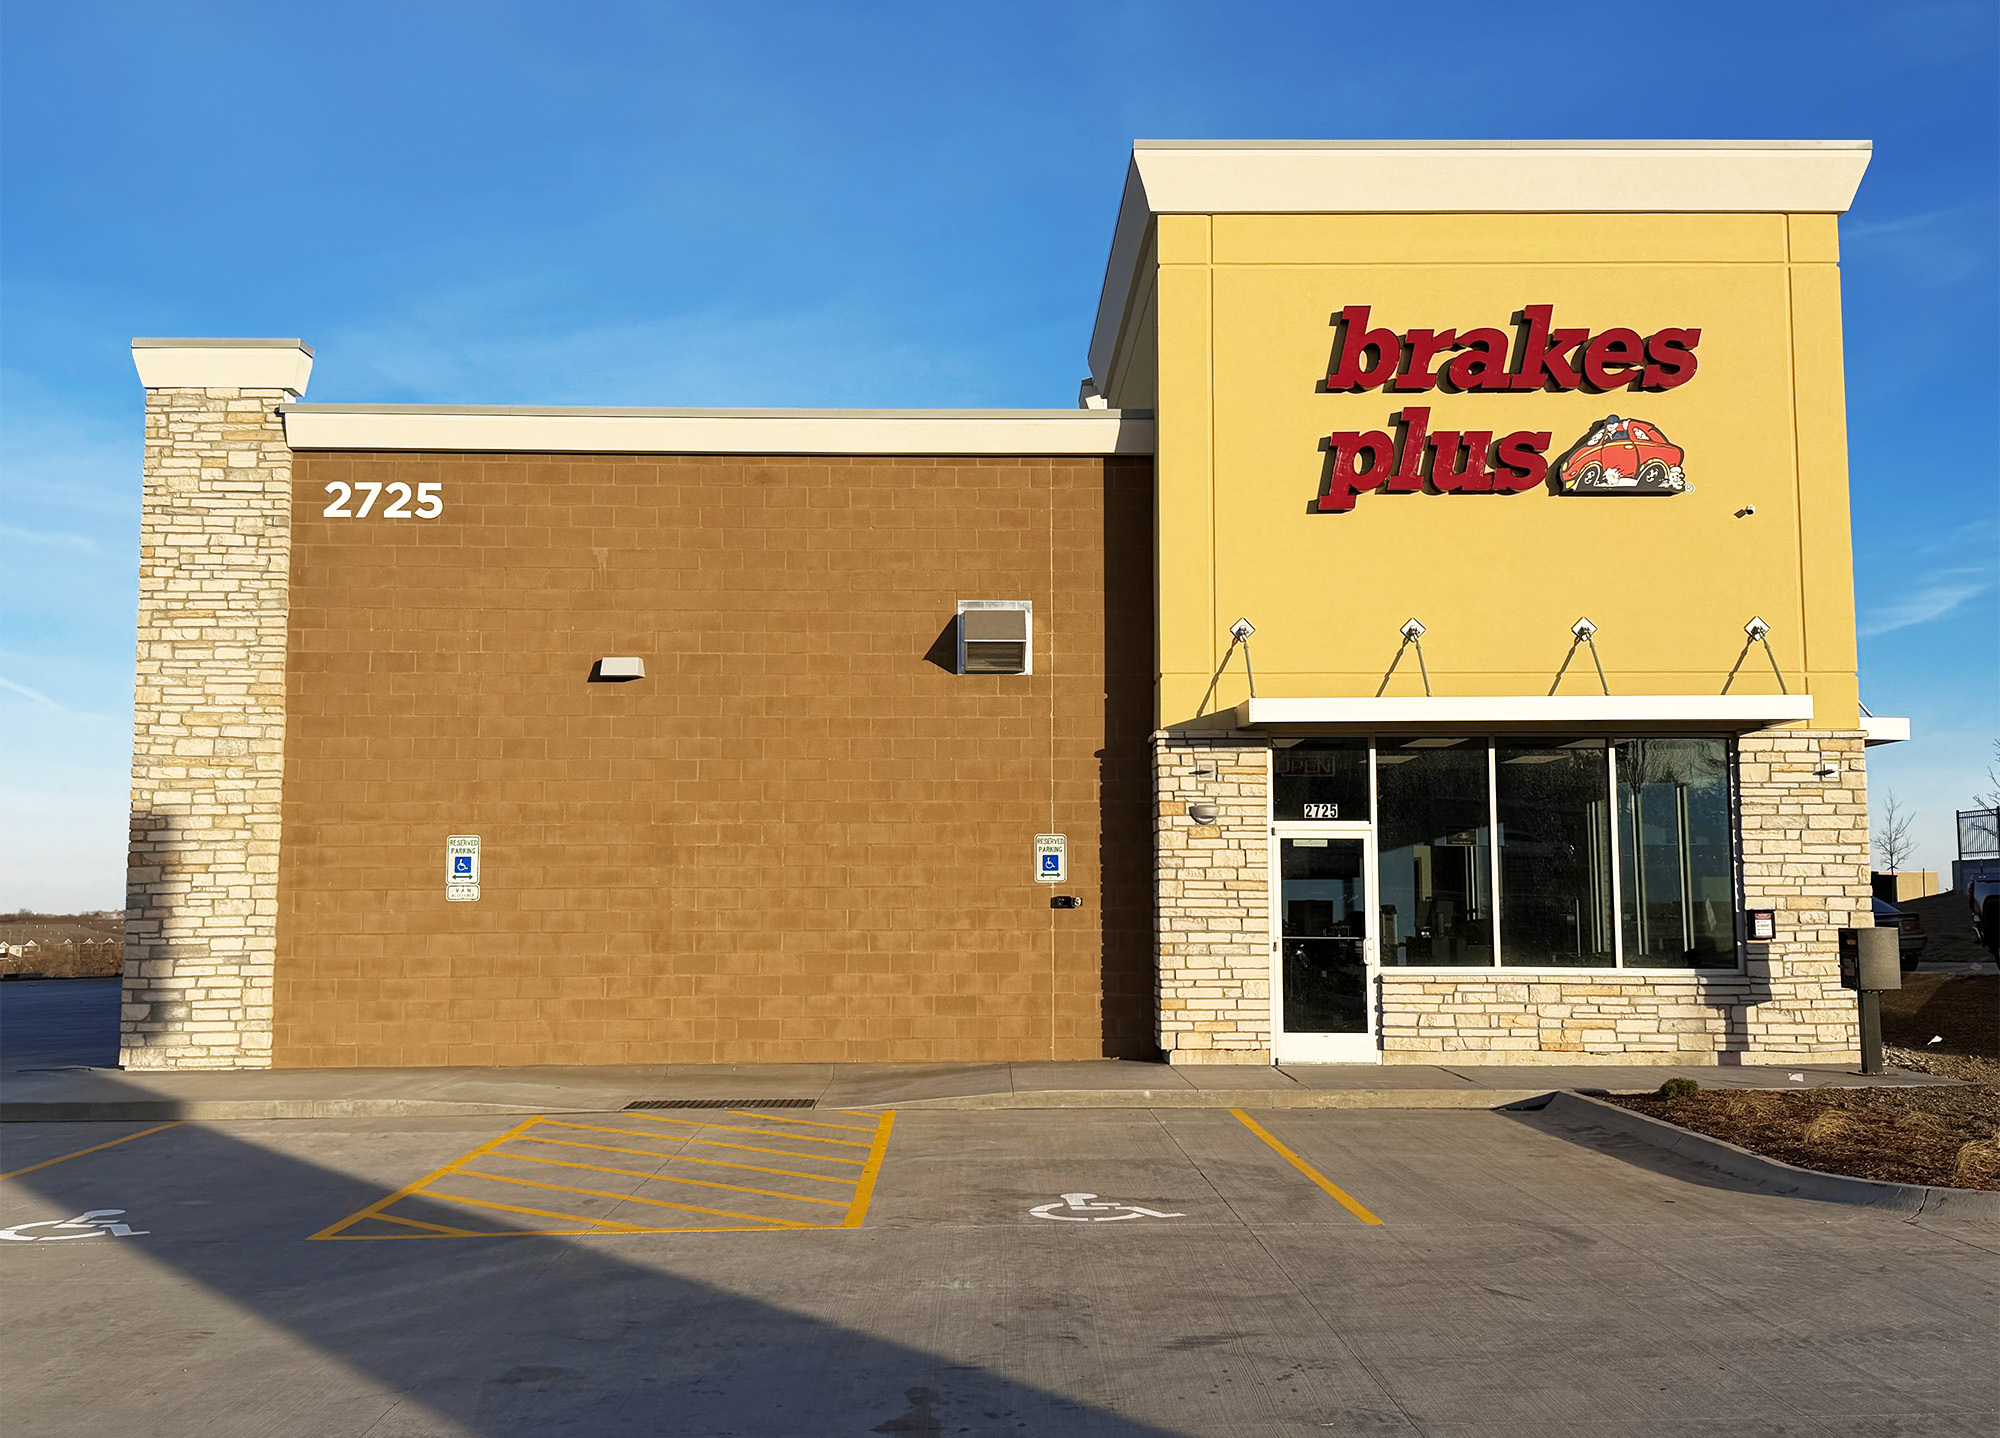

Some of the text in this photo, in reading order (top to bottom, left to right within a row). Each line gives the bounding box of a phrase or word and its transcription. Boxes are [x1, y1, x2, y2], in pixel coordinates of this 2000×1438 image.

[1327, 304, 1702, 390] brakes
[1318, 406, 1552, 511] plus
[323, 481, 444, 519] 2725
[1275, 758, 1332, 774] OPEN
[1305, 804, 1337, 818] 2725
